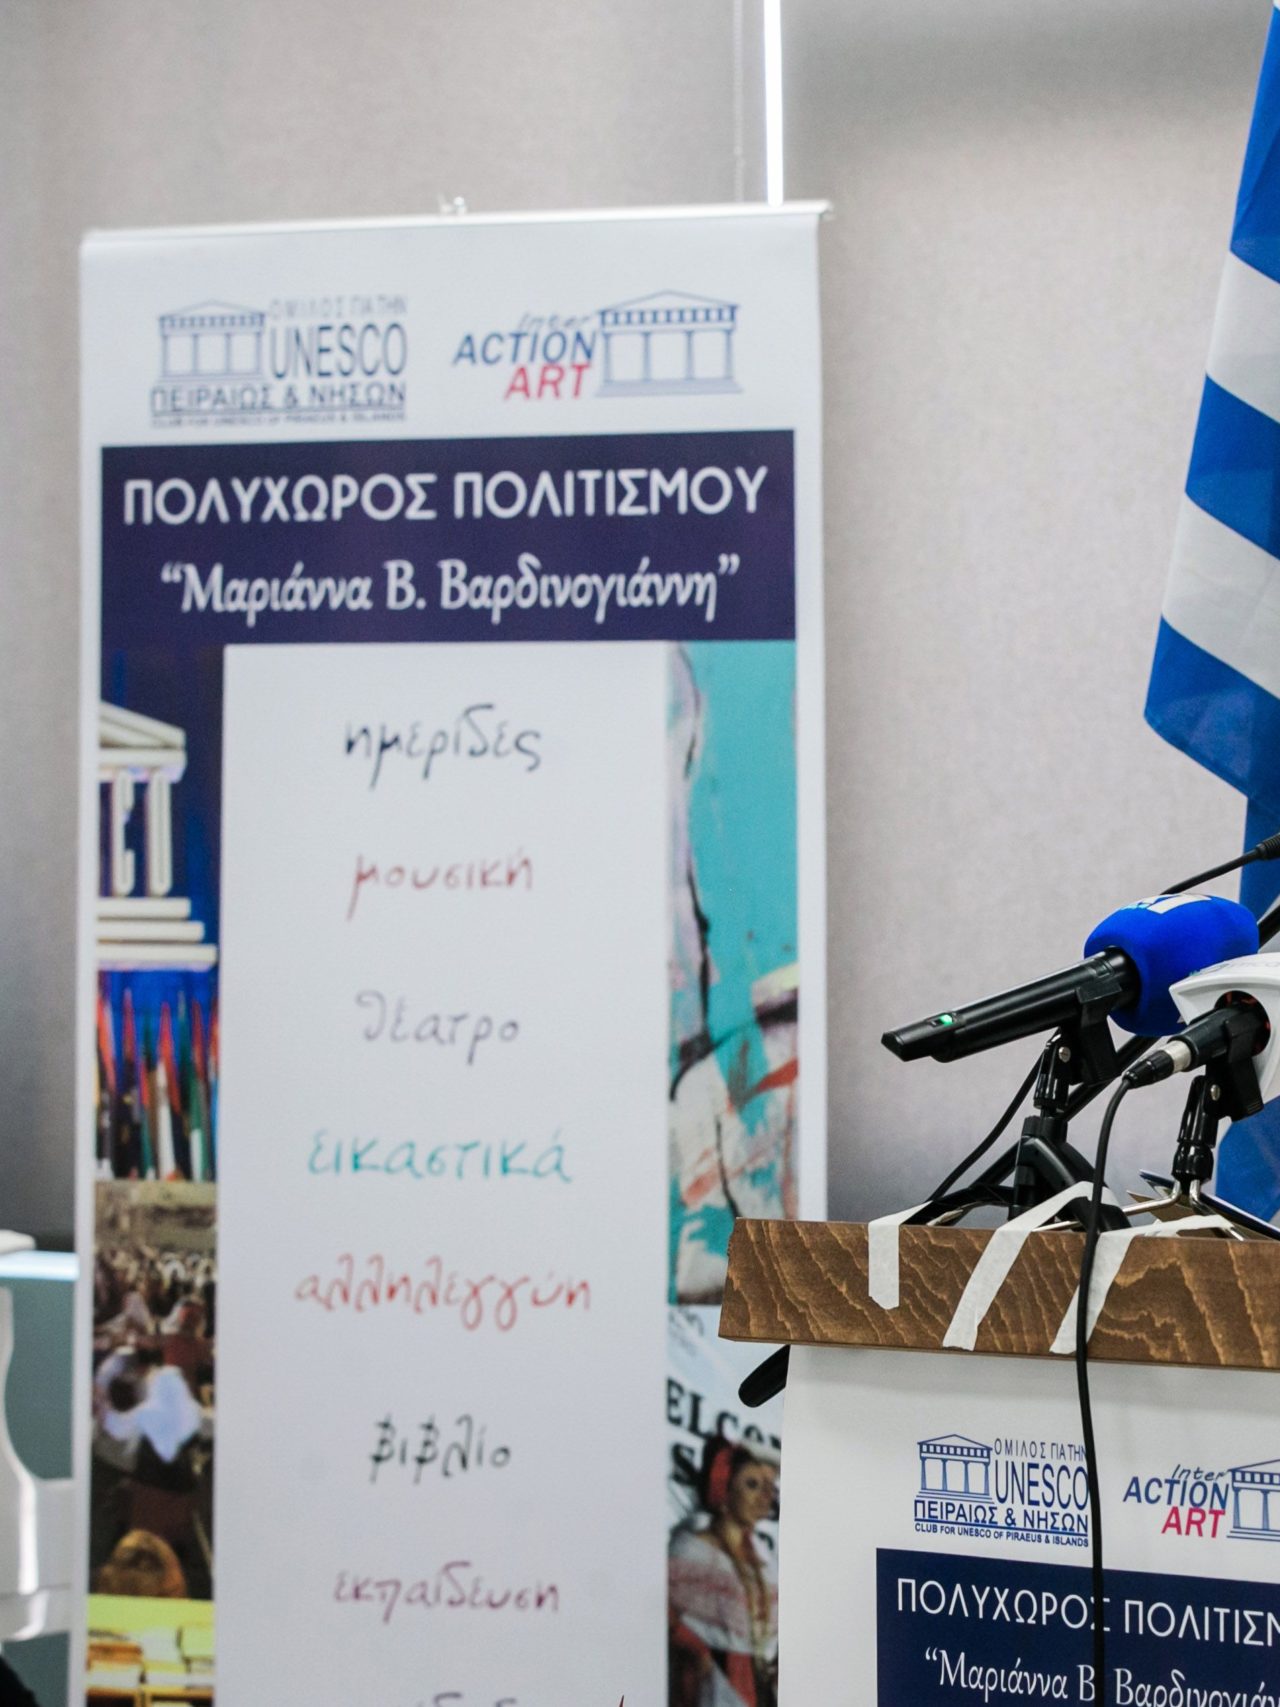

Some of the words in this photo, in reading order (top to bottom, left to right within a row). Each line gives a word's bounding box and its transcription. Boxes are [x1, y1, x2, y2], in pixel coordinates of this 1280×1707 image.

[270, 320, 408, 380] UNESCO
[452, 330, 597, 367] ACTION
[503, 362, 591, 400] ART
[124, 473, 437, 525] ΠΟΛΥΧΩΡΟΣ
[454, 465, 768, 519] ΠΟΛΙΤΙΣΜΟΥ
[383, 558, 426, 610] Β.
[308, 1127, 574, 1184] εικαστικά
[294, 1253, 592, 1332] αλληλεγγύη
[994, 1438, 1046, 1460] ΟΜΙΛΟΣ
[994, 1459, 1090, 1511] UNESCO
[1171, 1464, 1227, 1482] Inter
[1122, 1476, 1229, 1510] ACTION
[914, 1499, 999, 1525] ΠΕΙΡΑΙΩΣ
[1004, 1507, 1017, 1527] &
[1023, 1509, 1088, 1533] ΝΗΣΩΝ
[1161, 1506, 1226, 1538] ART
[914, 1522, 938, 1534] CLUB
[940, 1525, 956, 1535] FOR
[957, 1527, 991, 1539] UNESCO
[993, 1530, 1004, 1540] OF
[1006, 1531, 1042, 1544] PIRAEUS
[1044, 1534, 1051, 1544] &
[1052, 1536, 1089, 1548] ISLANDS
